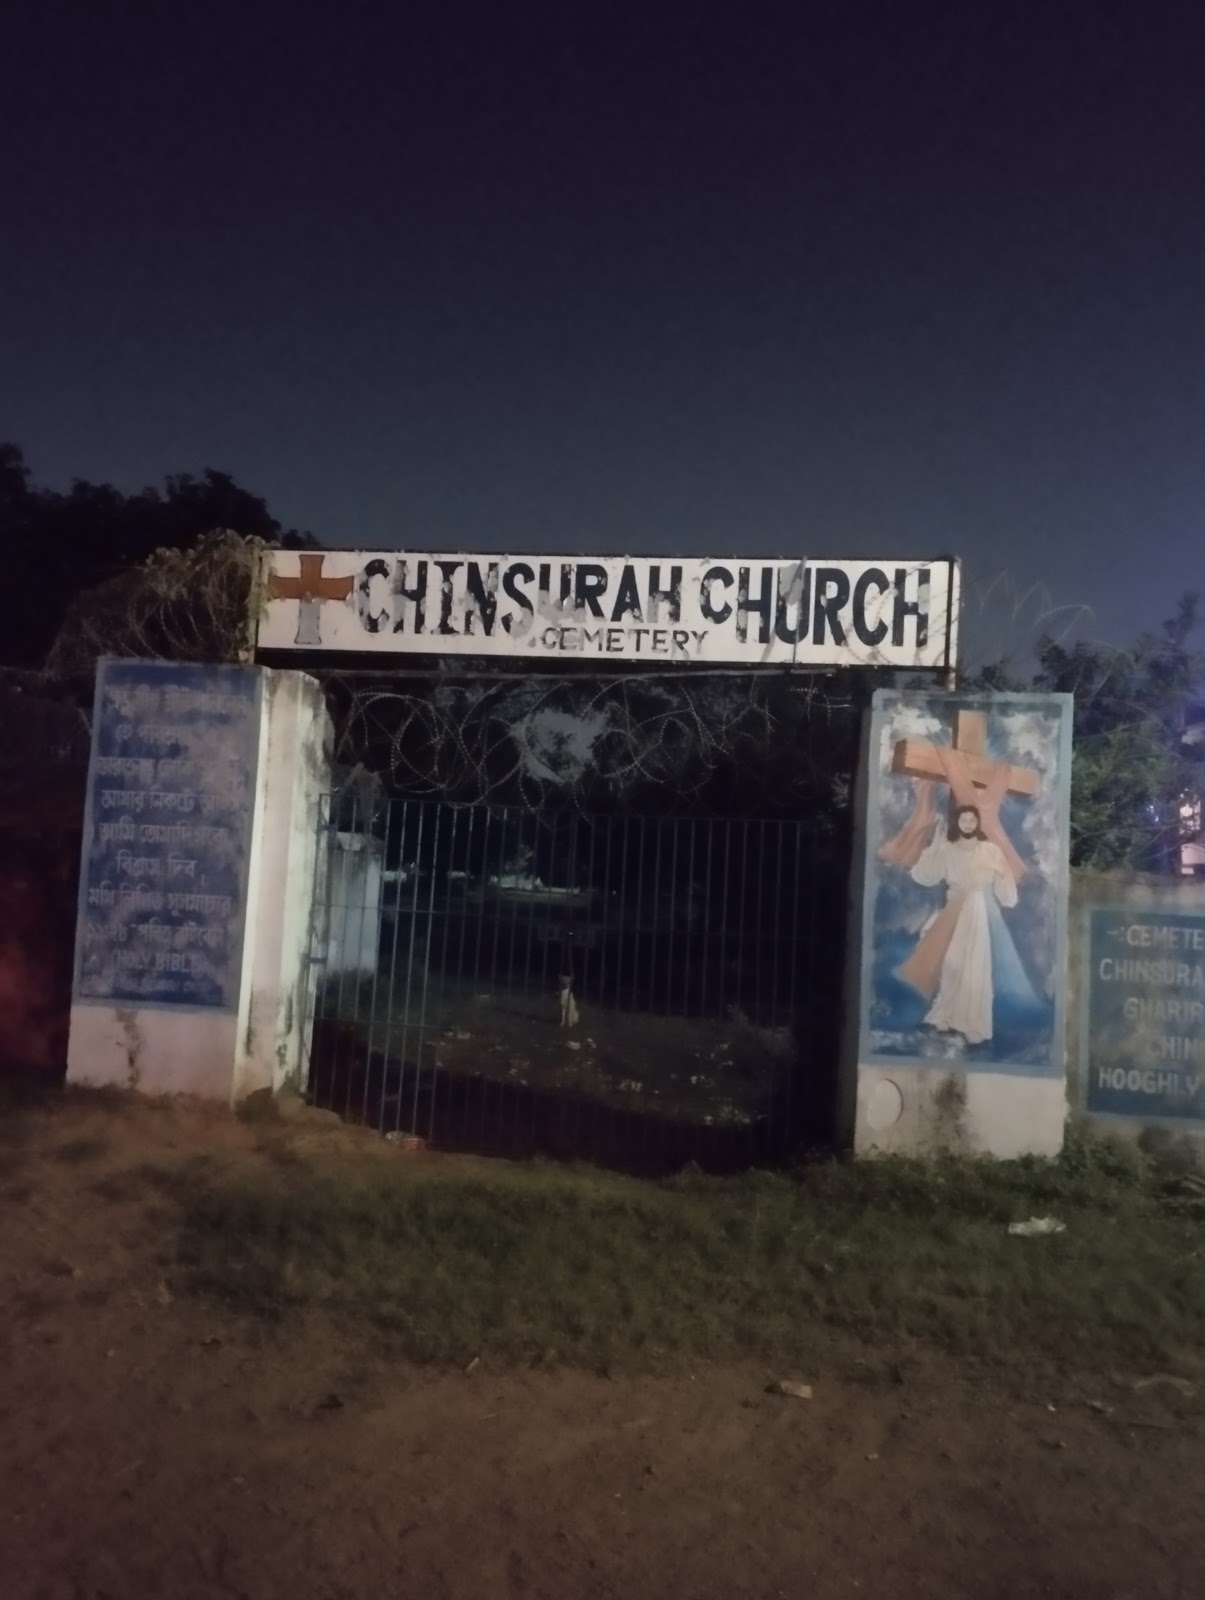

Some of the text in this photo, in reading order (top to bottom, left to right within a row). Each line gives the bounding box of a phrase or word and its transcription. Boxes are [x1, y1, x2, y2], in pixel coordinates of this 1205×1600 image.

[358, 558, 931, 648] CHINSURAH CHURCH
[541, 627, 708, 659] CEMETERY
[101, 789, 146, 813] আমার
[148, 784, 197, 813] নিকটে
[98, 815, 136, 842] আমি
